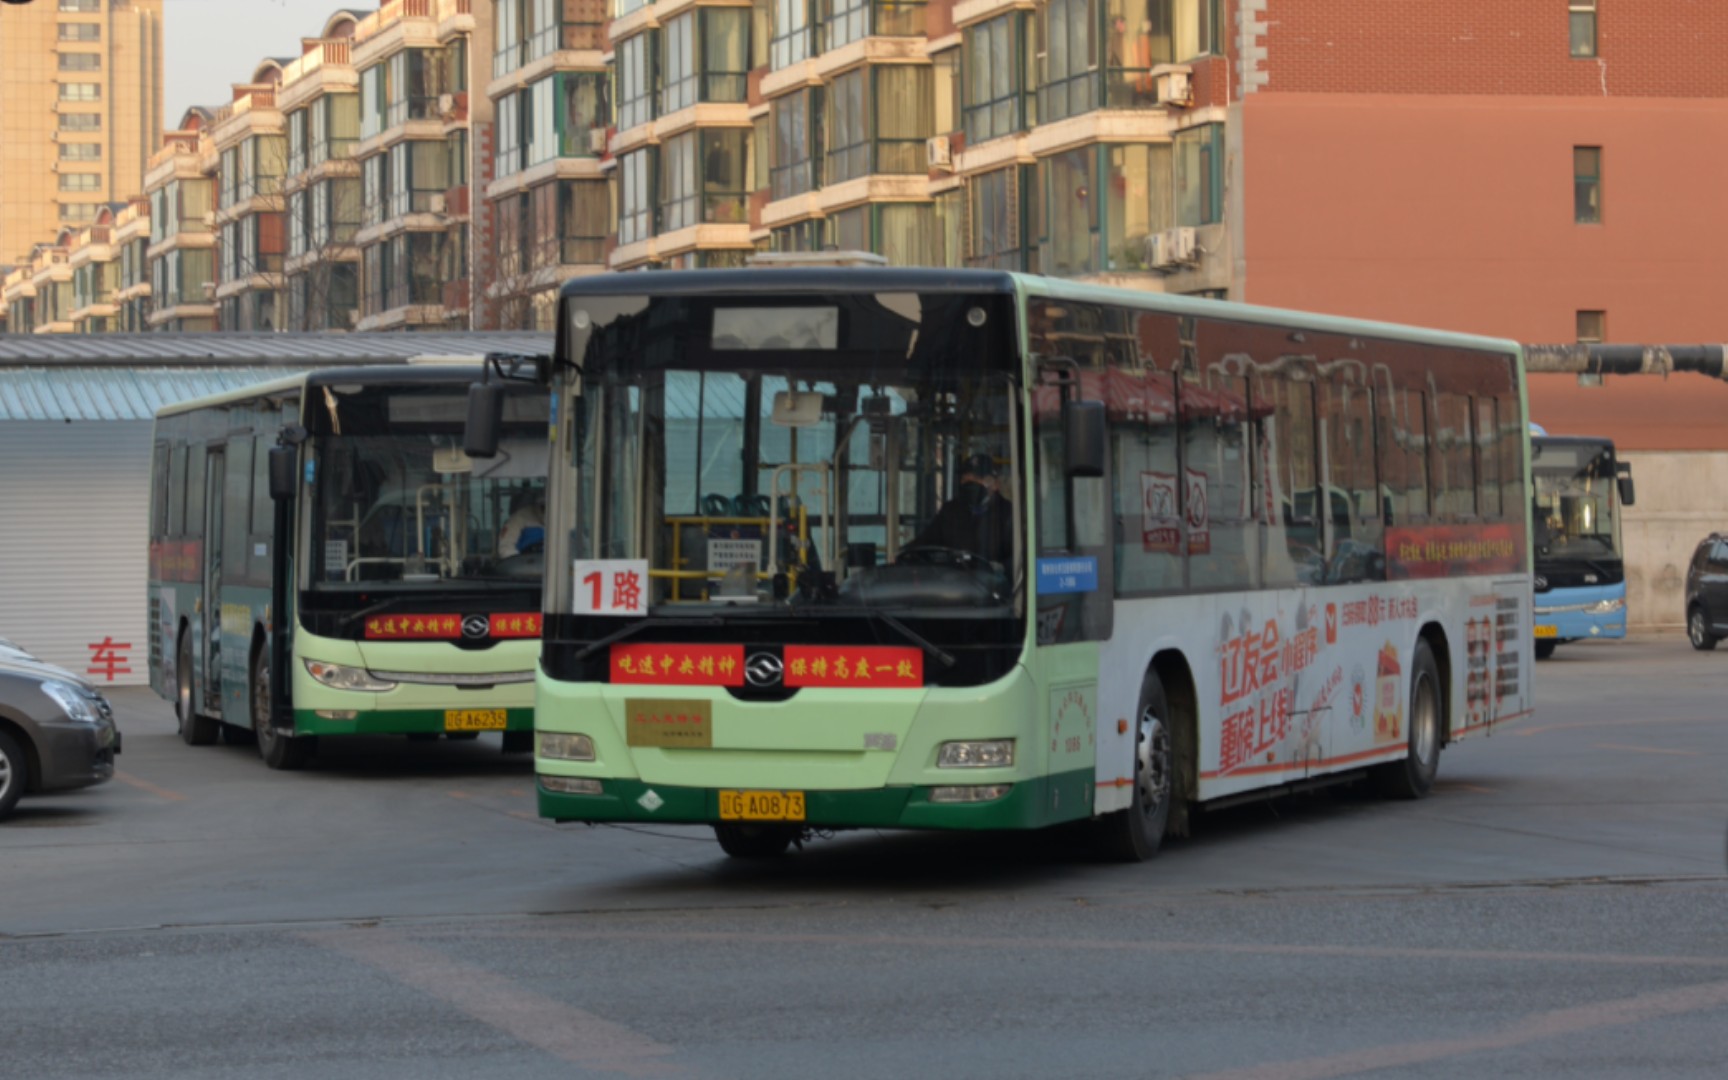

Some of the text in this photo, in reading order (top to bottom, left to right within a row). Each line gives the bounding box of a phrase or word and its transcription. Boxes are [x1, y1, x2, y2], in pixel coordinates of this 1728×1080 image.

[582, 570, 641, 610] 1路
[495, 616, 542, 633] 保持高
[86, 635, 132, 681] 车
[790, 655, 916, 679] 保持高度一致
